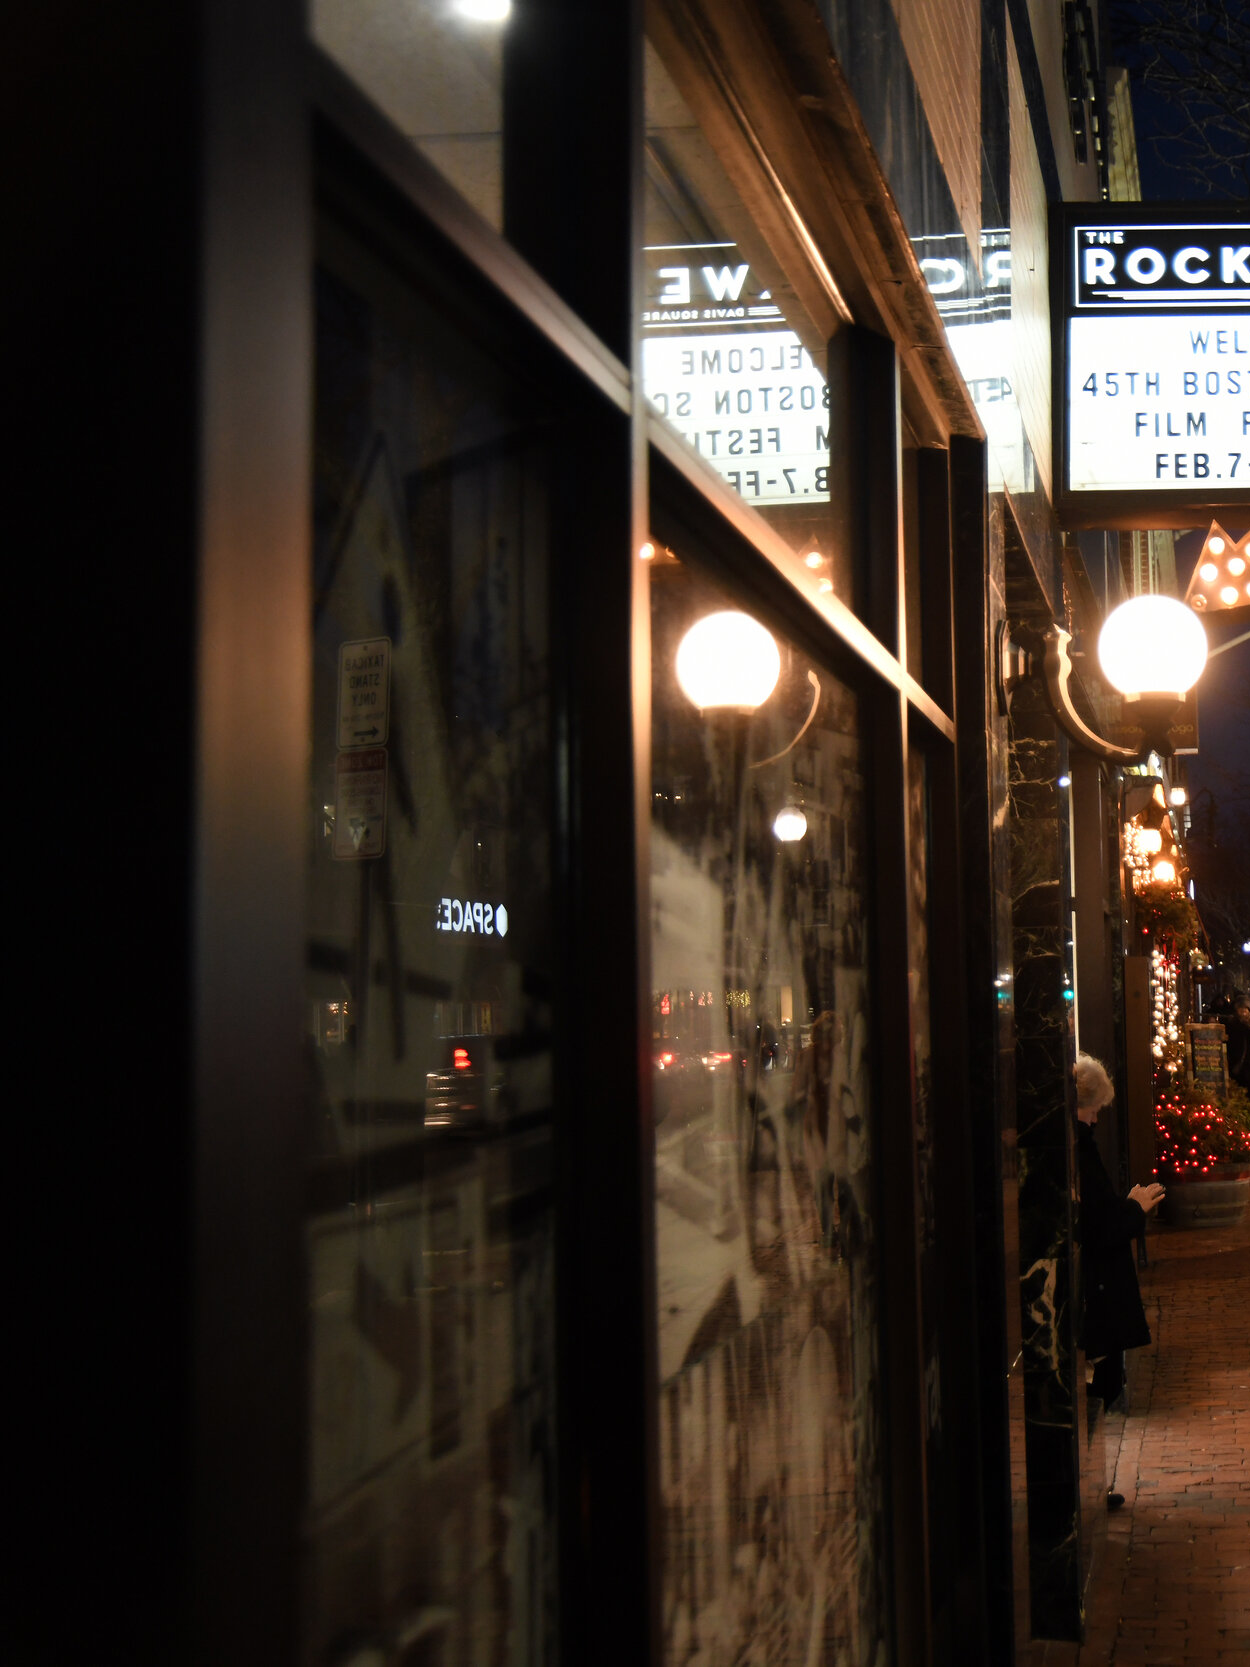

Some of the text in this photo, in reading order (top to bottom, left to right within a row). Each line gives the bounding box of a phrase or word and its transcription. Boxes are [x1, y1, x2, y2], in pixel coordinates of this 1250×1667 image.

[1085, 231, 1124, 244] THE
[1082, 371, 1160, 397] 45TH
[1135, 411, 1207, 437] FILM
